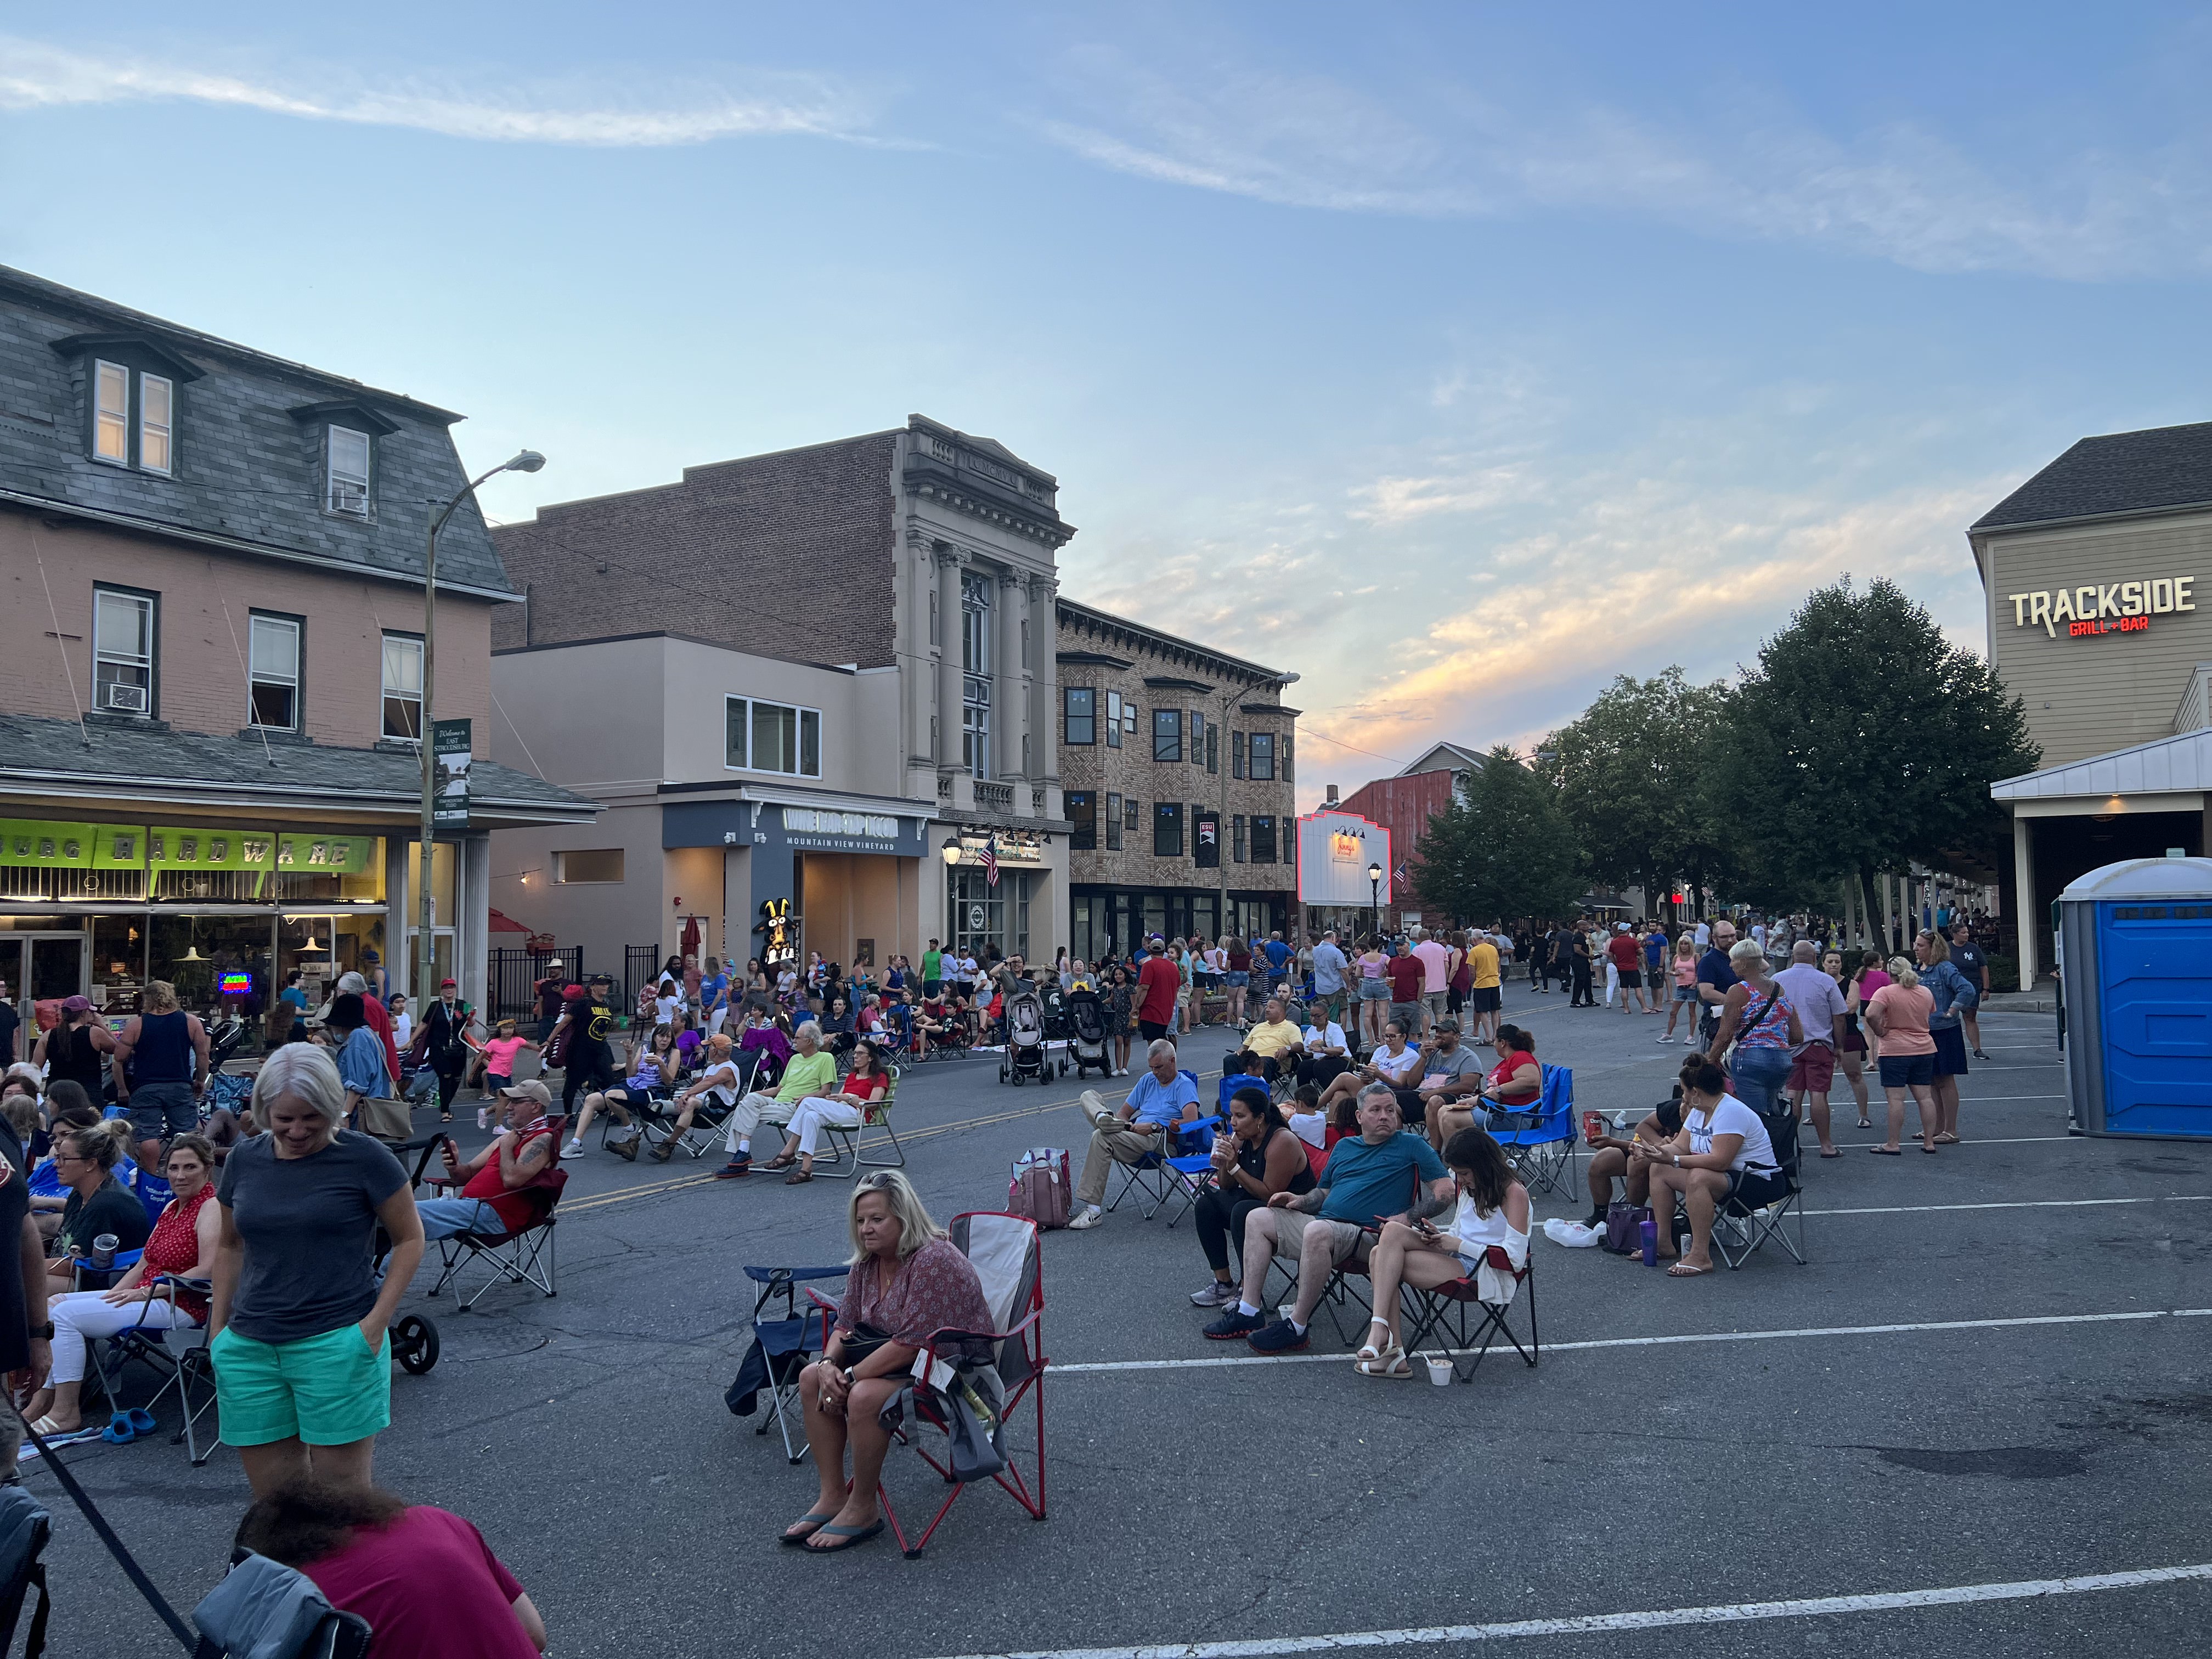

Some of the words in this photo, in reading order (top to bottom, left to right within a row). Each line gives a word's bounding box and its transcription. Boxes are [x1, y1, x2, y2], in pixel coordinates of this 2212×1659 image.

[2008, 575, 2196, 638] TRACKSIDE
[2069, 620, 2109, 636] GRILL
[2120, 616, 2149, 631] BAR
[783, 809, 816, 832] WINE
[816, 811, 842, 833] BAR
[865, 816, 899, 838] ROOM
[114, 836, 350, 866] HARDWARE
[787, 837, 832, 847] MOUNTAIN
[834, 840, 854, 849] VIEW
[856, 842, 895, 851] VINEYARD
[177, 995, 192, 1007] PEN
